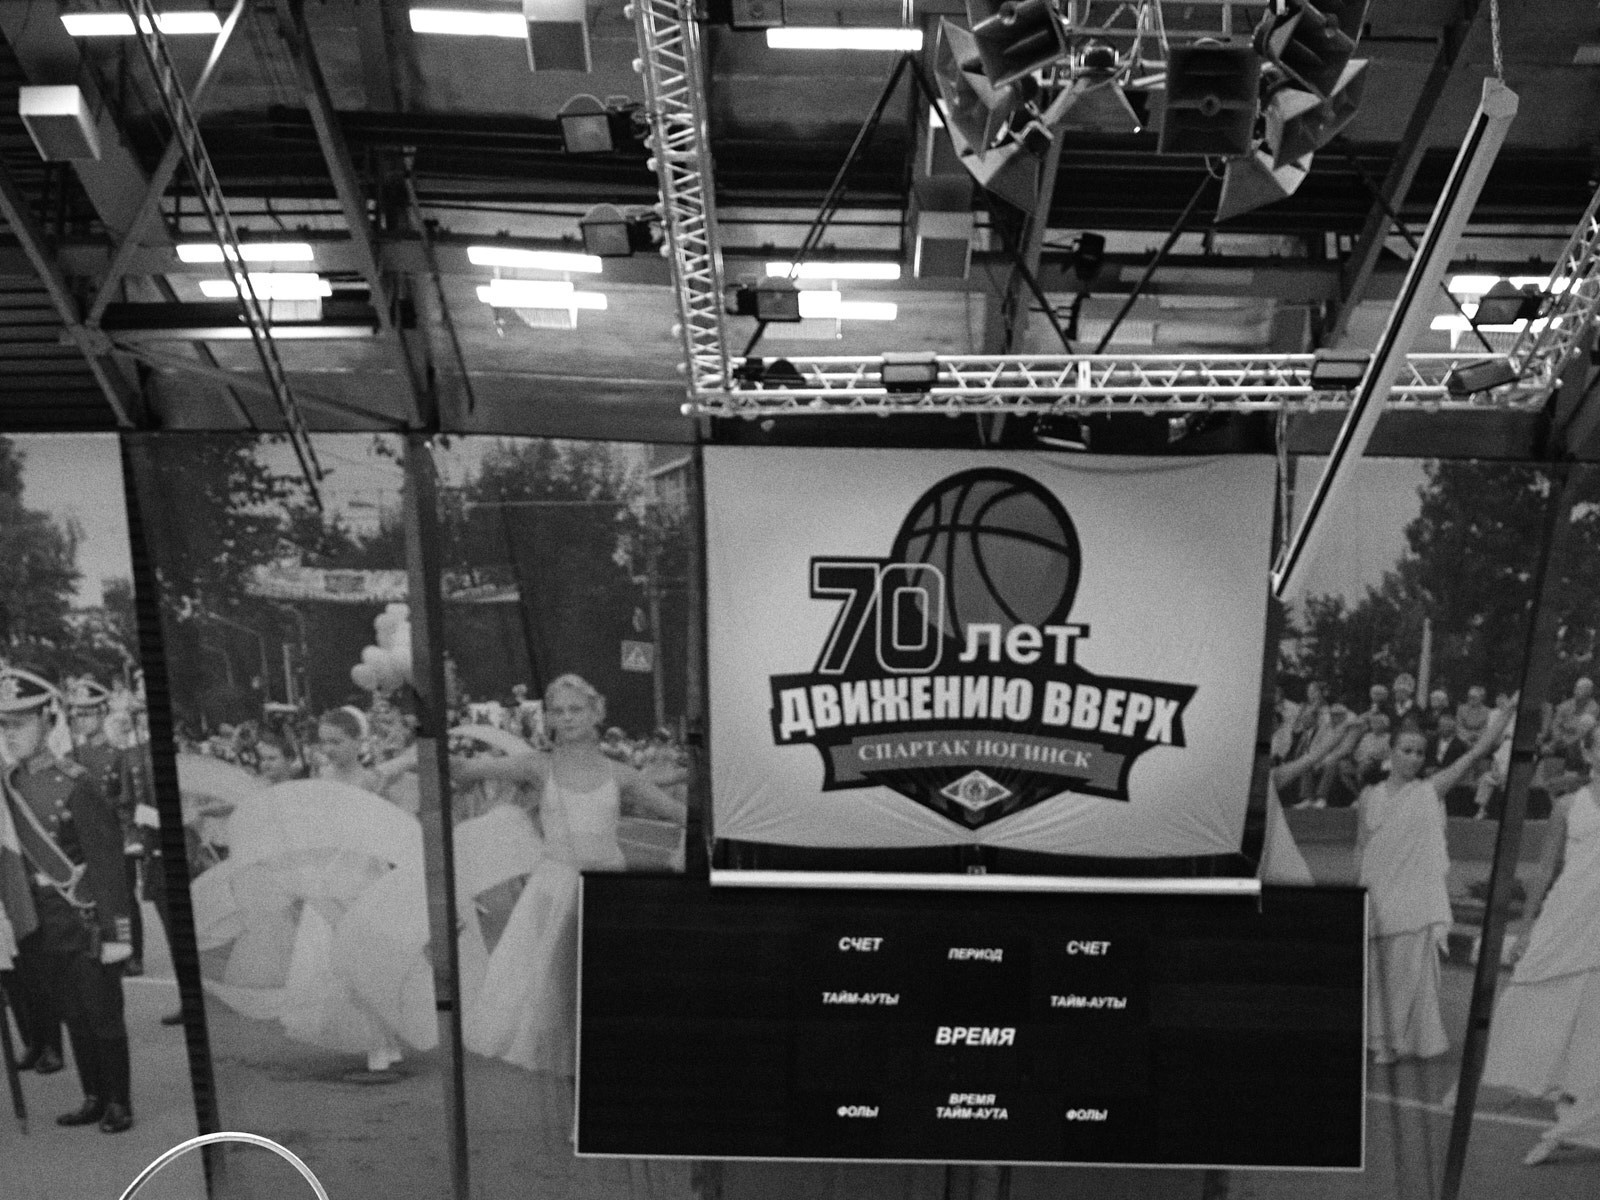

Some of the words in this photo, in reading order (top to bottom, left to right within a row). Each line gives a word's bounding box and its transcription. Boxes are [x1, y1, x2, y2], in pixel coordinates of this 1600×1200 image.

[813, 562, 945, 675] 70
[959, 623, 1081, 665] лет
[780, 675, 1034, 740] ДВИЖЕНИЮ
[1041, 680, 1180, 744] ВВЕРХ
[858, 740, 971, 762] СПАРТАК
[974, 739, 1092, 769] НОГИНСК
[838, 936, 884, 952] СЧЕТ
[1066, 940, 1111, 956] СЧЕТ
[947, 947, 1004, 962] ПЕРИОД
[821, 990, 900, 1006] ТАЙМ-АУТЫ
[1050, 993, 1128, 1009] ТАЙМ-АУТЫ
[934, 1025, 1017, 1047] ВРЕМЯ
[948, 1092, 997, 1105] ВРЕМЯ
[836, 1105, 880, 1118] ФОЛЫ
[936, 1105, 1009, 1120] ТАЙМ-АУТА
[1065, 1108, 1109, 1121] ФОЛЫ
